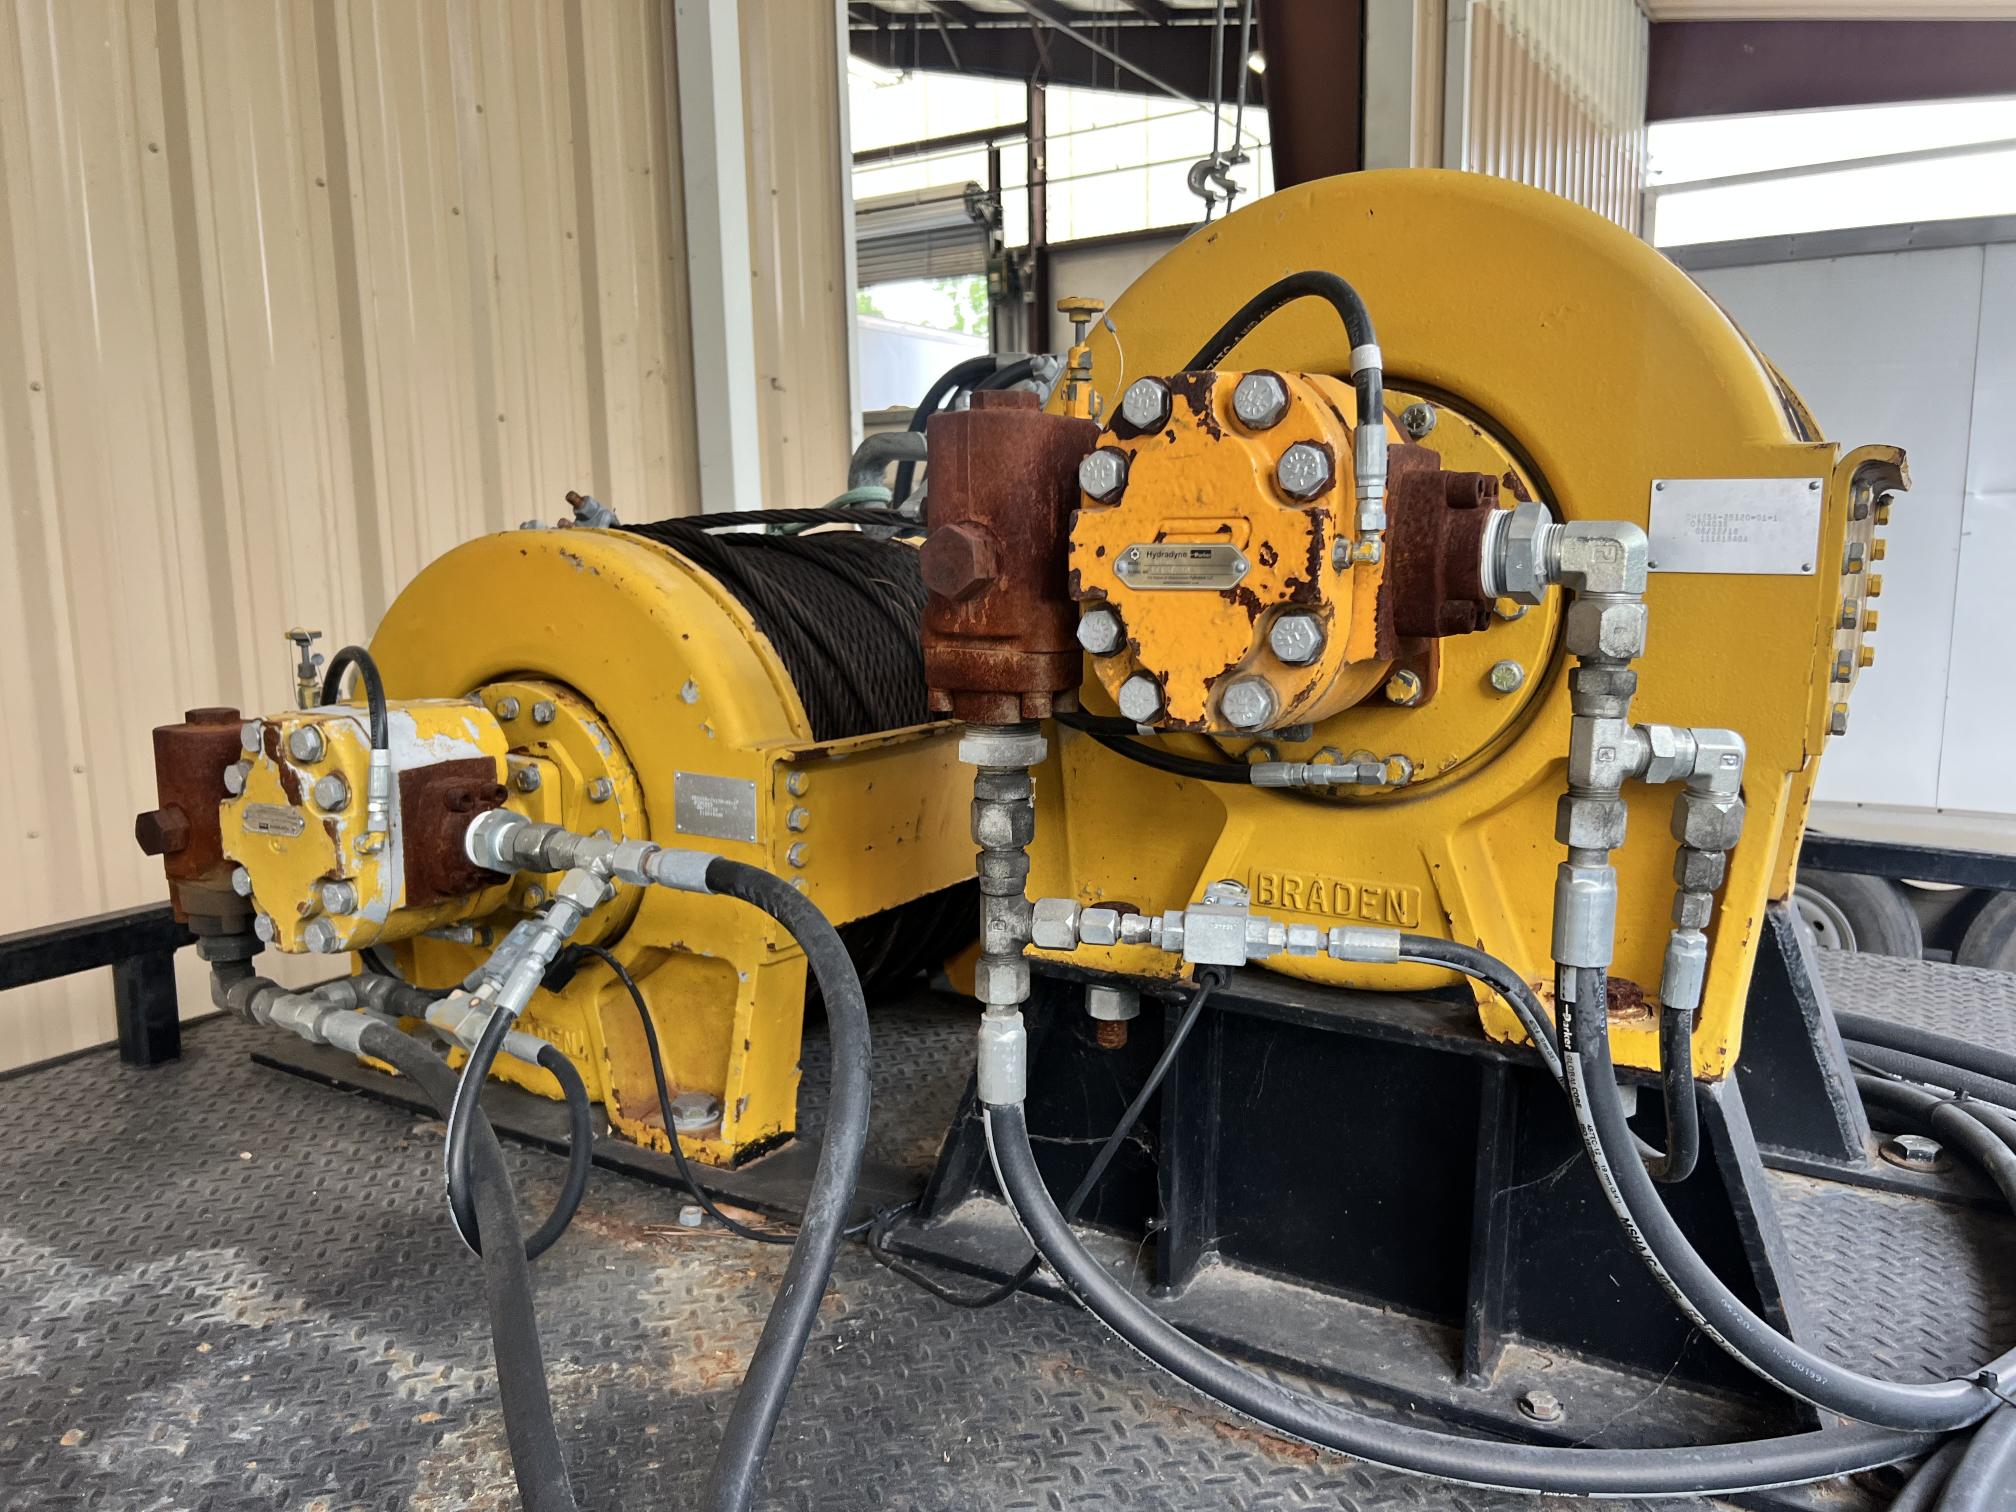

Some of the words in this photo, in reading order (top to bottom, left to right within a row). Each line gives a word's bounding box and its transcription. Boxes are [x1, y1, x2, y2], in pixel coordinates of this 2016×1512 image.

[1146, 551, 1188, 559] Hydradyne
[1257, 872, 1408, 924] BRADEN
[1562, 1004, 1573, 1050] Parker
[1620, 1217, 1647, 1253] MSHA
